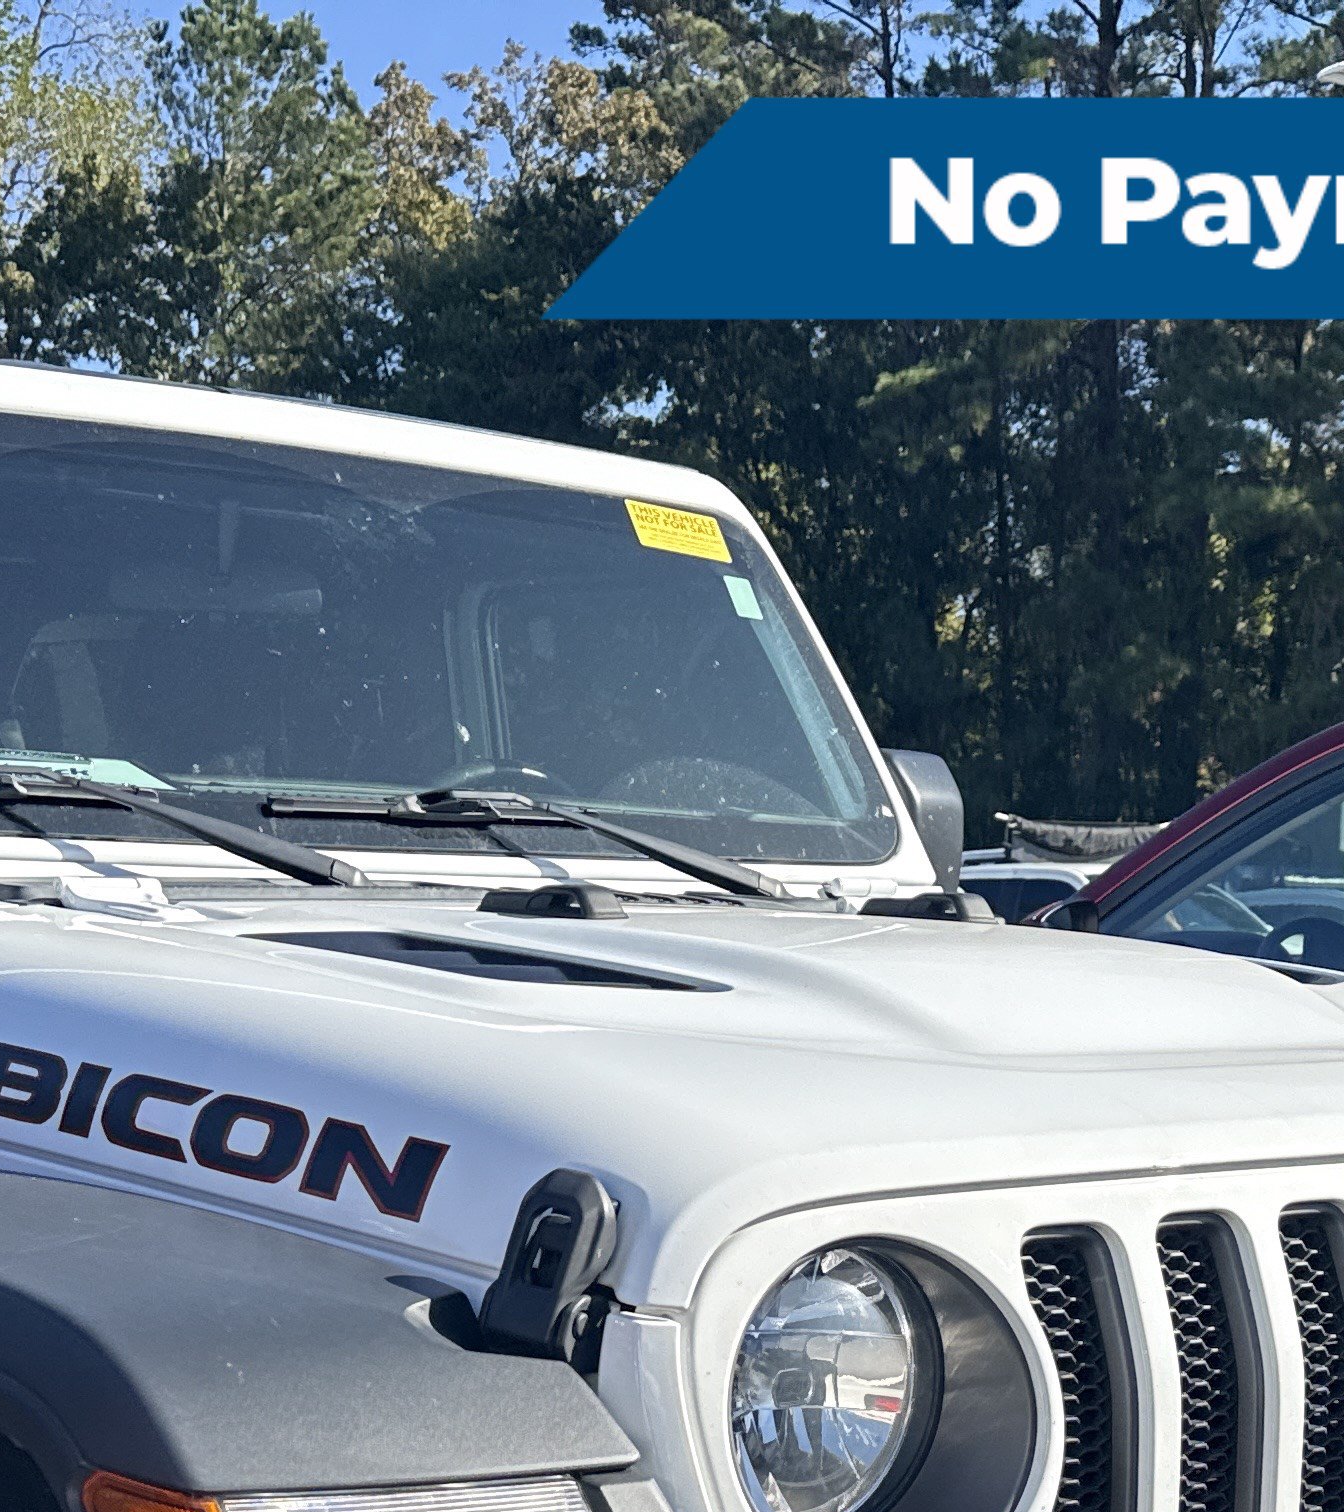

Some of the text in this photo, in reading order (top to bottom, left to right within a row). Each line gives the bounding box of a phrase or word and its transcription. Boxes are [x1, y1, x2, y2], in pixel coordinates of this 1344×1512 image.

[631, 503, 716, 530] THIS VEHICLE
[636, 513, 660, 526] NOT
[663, 519, 688, 531] FOR
[690, 523, 718, 538] SALE
